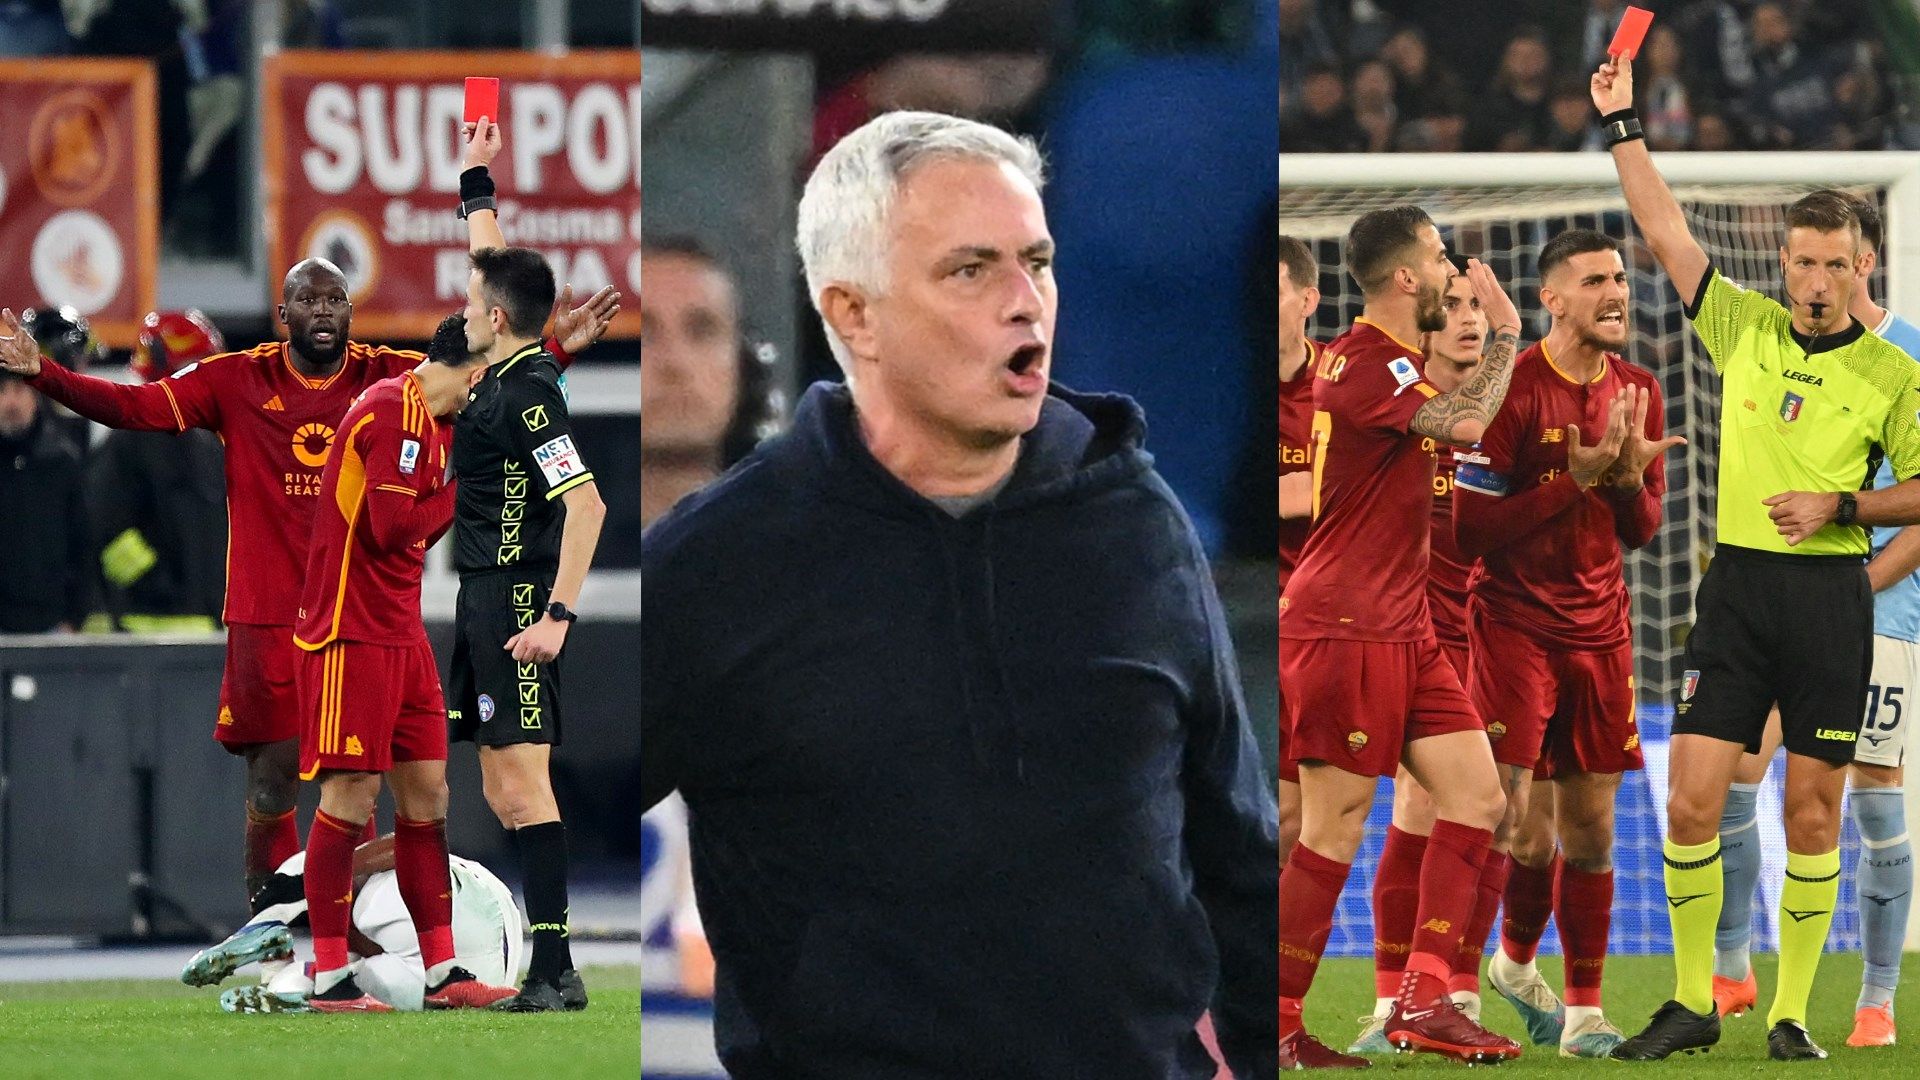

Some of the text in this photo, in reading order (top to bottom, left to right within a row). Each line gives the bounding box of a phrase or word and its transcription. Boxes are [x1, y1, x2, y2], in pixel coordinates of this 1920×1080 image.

[301, 81, 467, 196] SUD
[1782, 368, 1824, 387] LEGEA
[535, 437, 570, 463] NET
[285, 485, 321, 496] SEAS
[1865, 684, 1904, 732] 15
[1815, 728, 1857, 742] LEGEA
